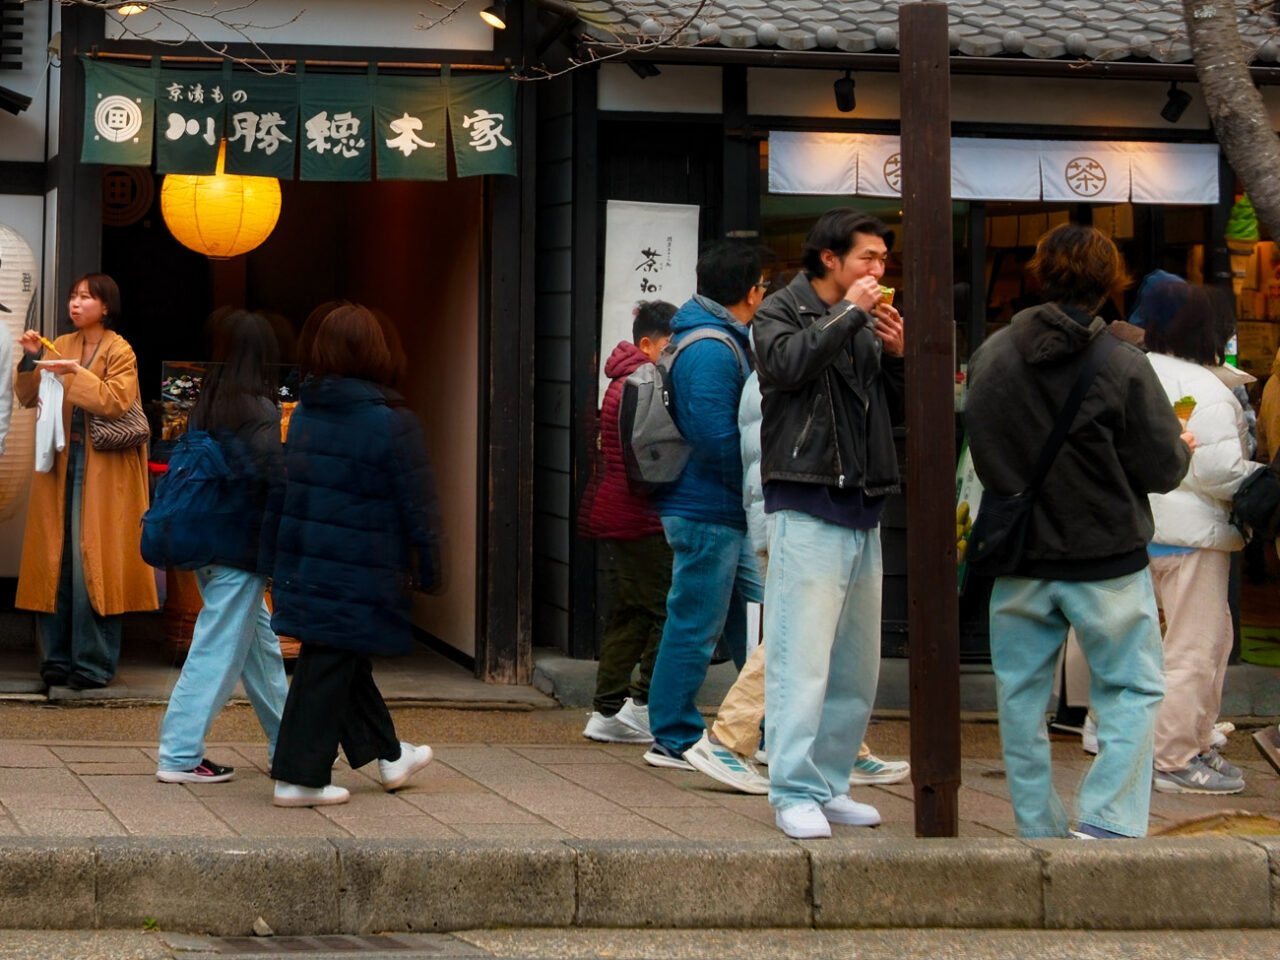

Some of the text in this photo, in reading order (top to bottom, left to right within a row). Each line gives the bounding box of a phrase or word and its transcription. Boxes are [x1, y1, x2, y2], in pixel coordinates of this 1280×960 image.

[166, 83, 247, 103] 京漬もの
[1069, 161, 1105, 193] 茶
